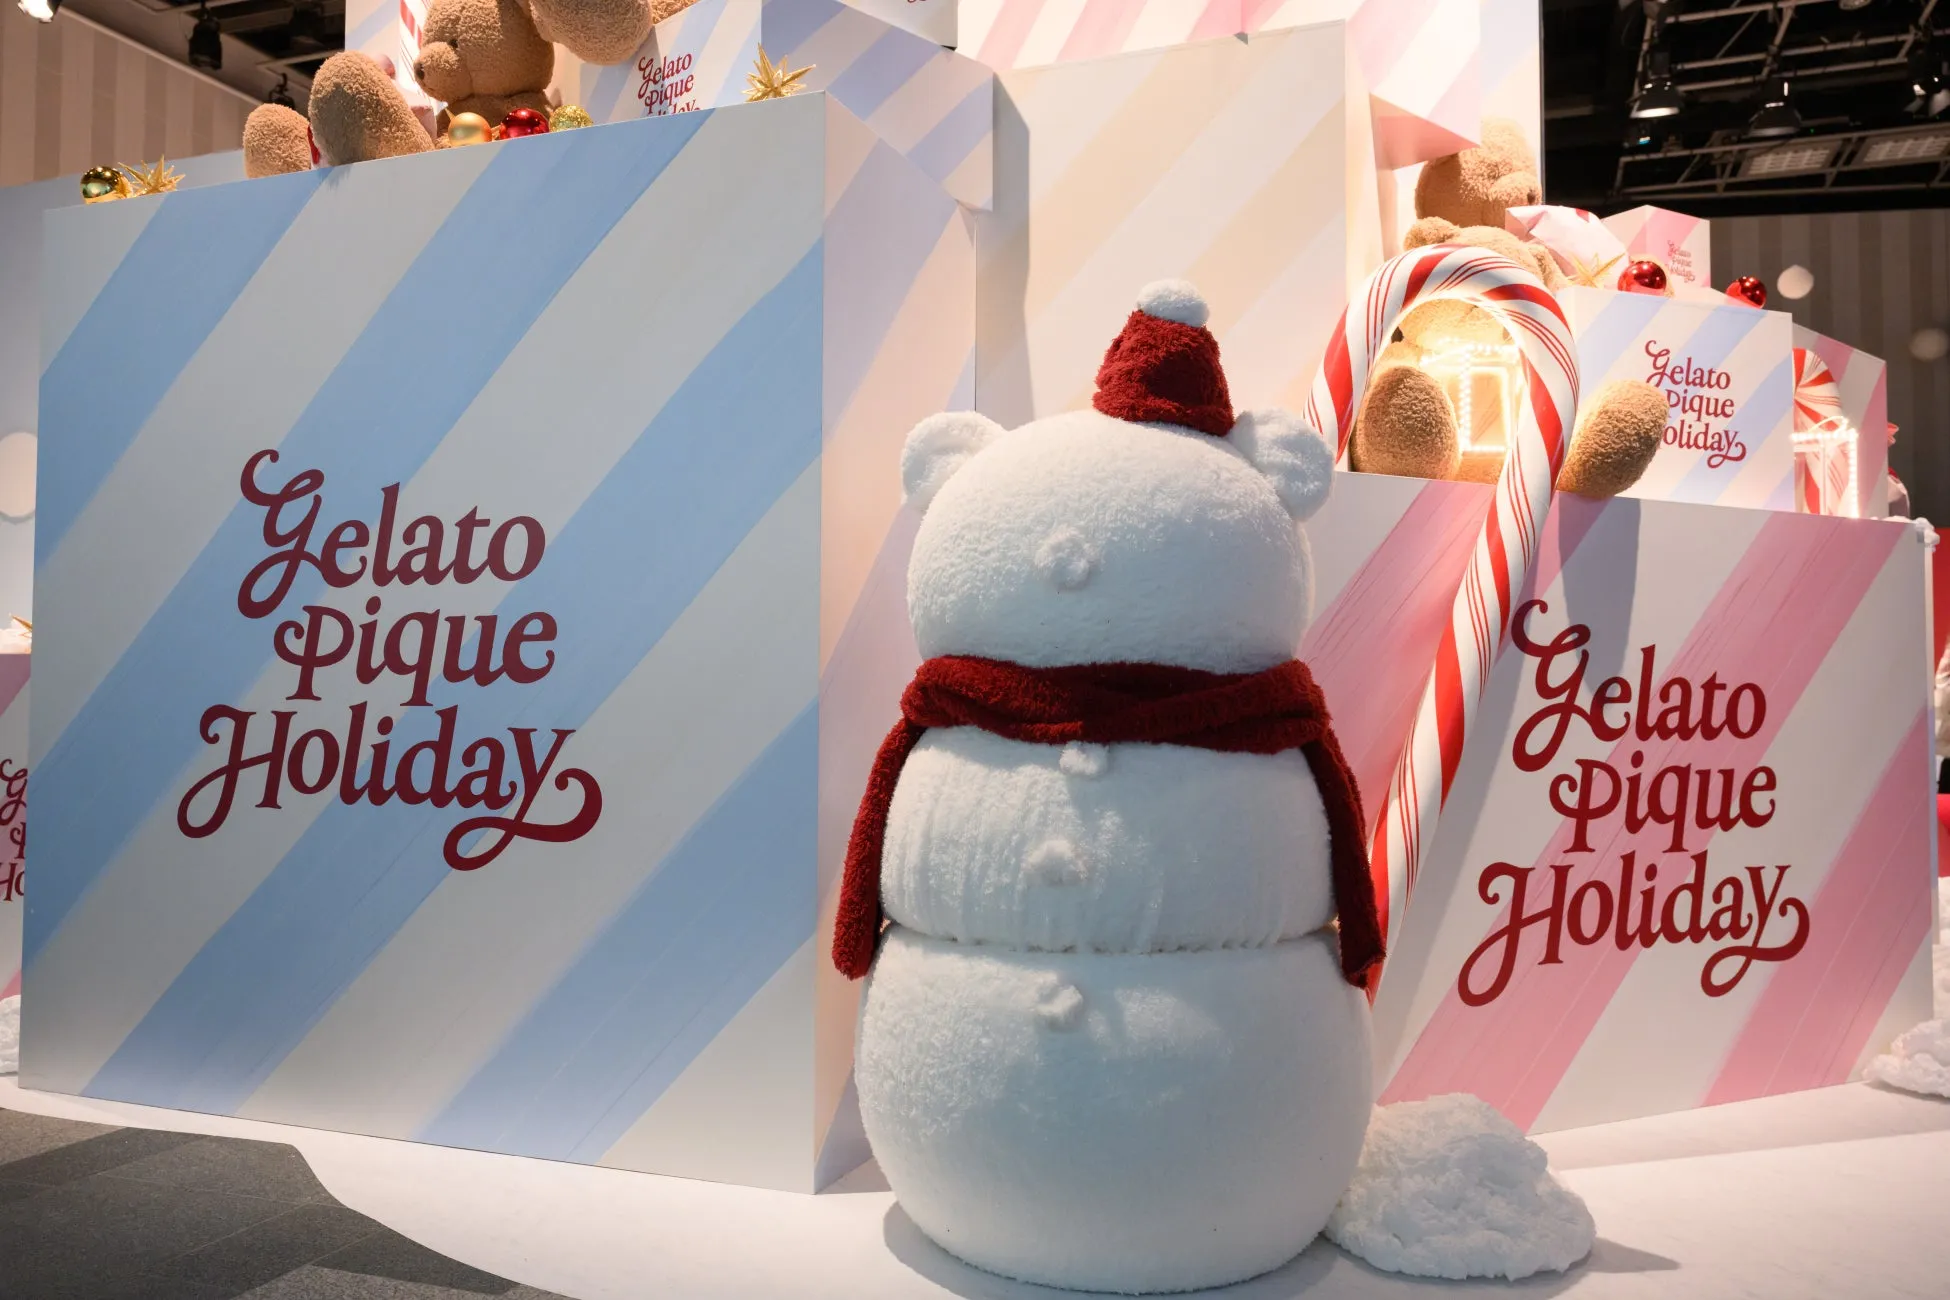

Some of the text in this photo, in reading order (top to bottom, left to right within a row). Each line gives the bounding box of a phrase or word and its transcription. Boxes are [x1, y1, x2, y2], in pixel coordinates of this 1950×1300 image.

[637, 53, 692, 99] Gelato
[644, 74, 694, 115] Pique
[1645, 340, 1731, 390] Gelato
[1662, 419, 1747, 469] oliday
[238, 449, 546, 619] Gelato
[273, 596, 558, 707] Pique
[1511, 599, 1767, 772] Gelato
[177, 700, 603, 871] Holiday
[1549, 750, 1777, 854] Pique
[1457, 849, 1810, 1007] Holiday
